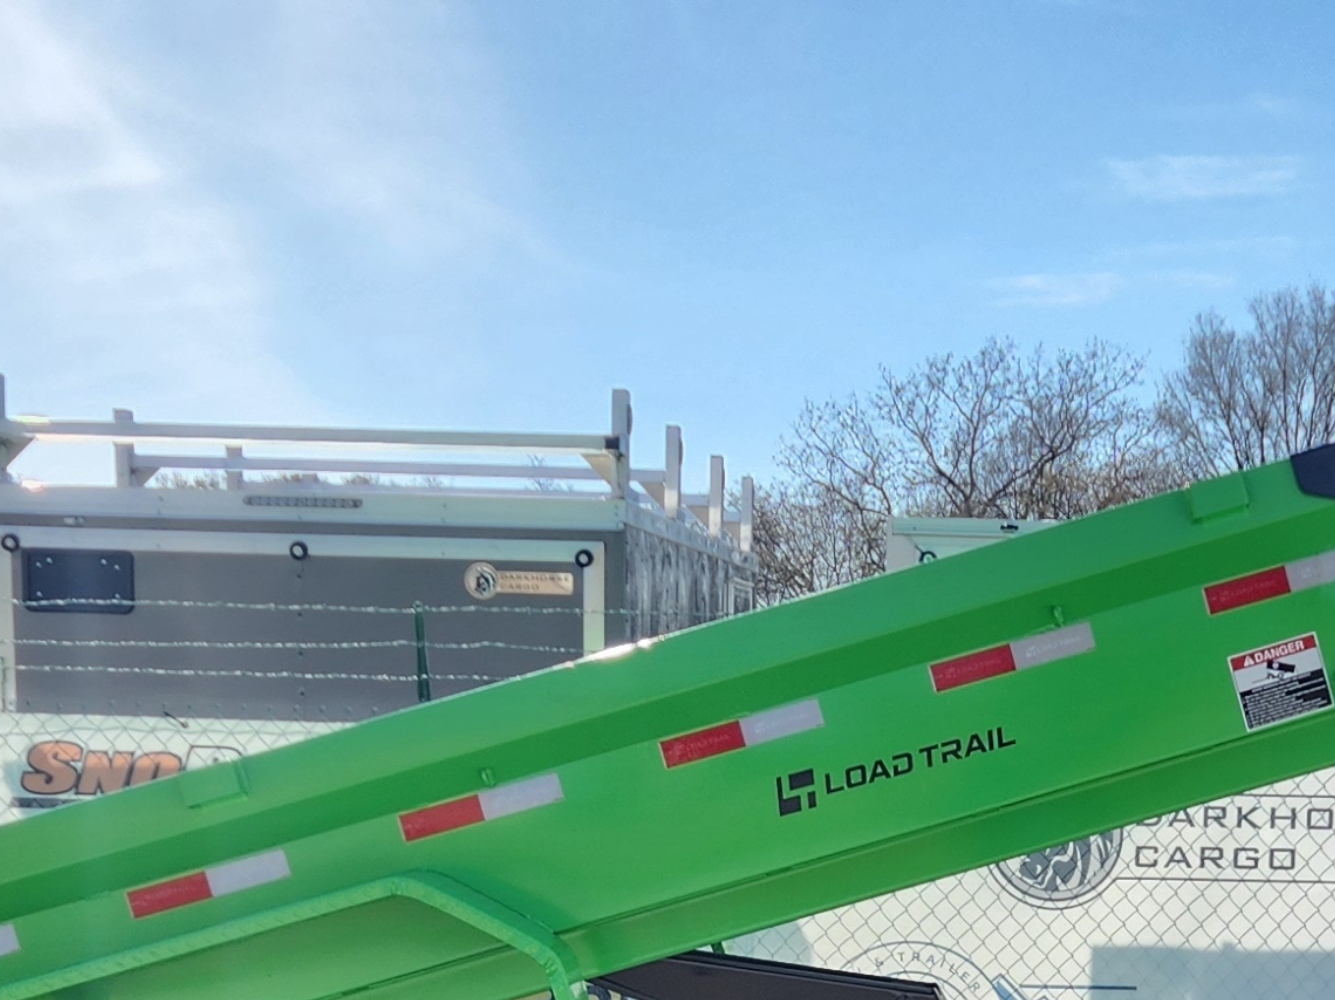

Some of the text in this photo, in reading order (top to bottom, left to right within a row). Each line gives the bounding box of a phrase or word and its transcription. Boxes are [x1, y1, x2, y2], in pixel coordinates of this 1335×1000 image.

[1254, 639, 1305, 664] DANGER
[824, 726, 1017, 795] LOAD TRAIL
[1135, 846, 1295, 870] CARGO
[897, 952, 981, 992] TRAILER
